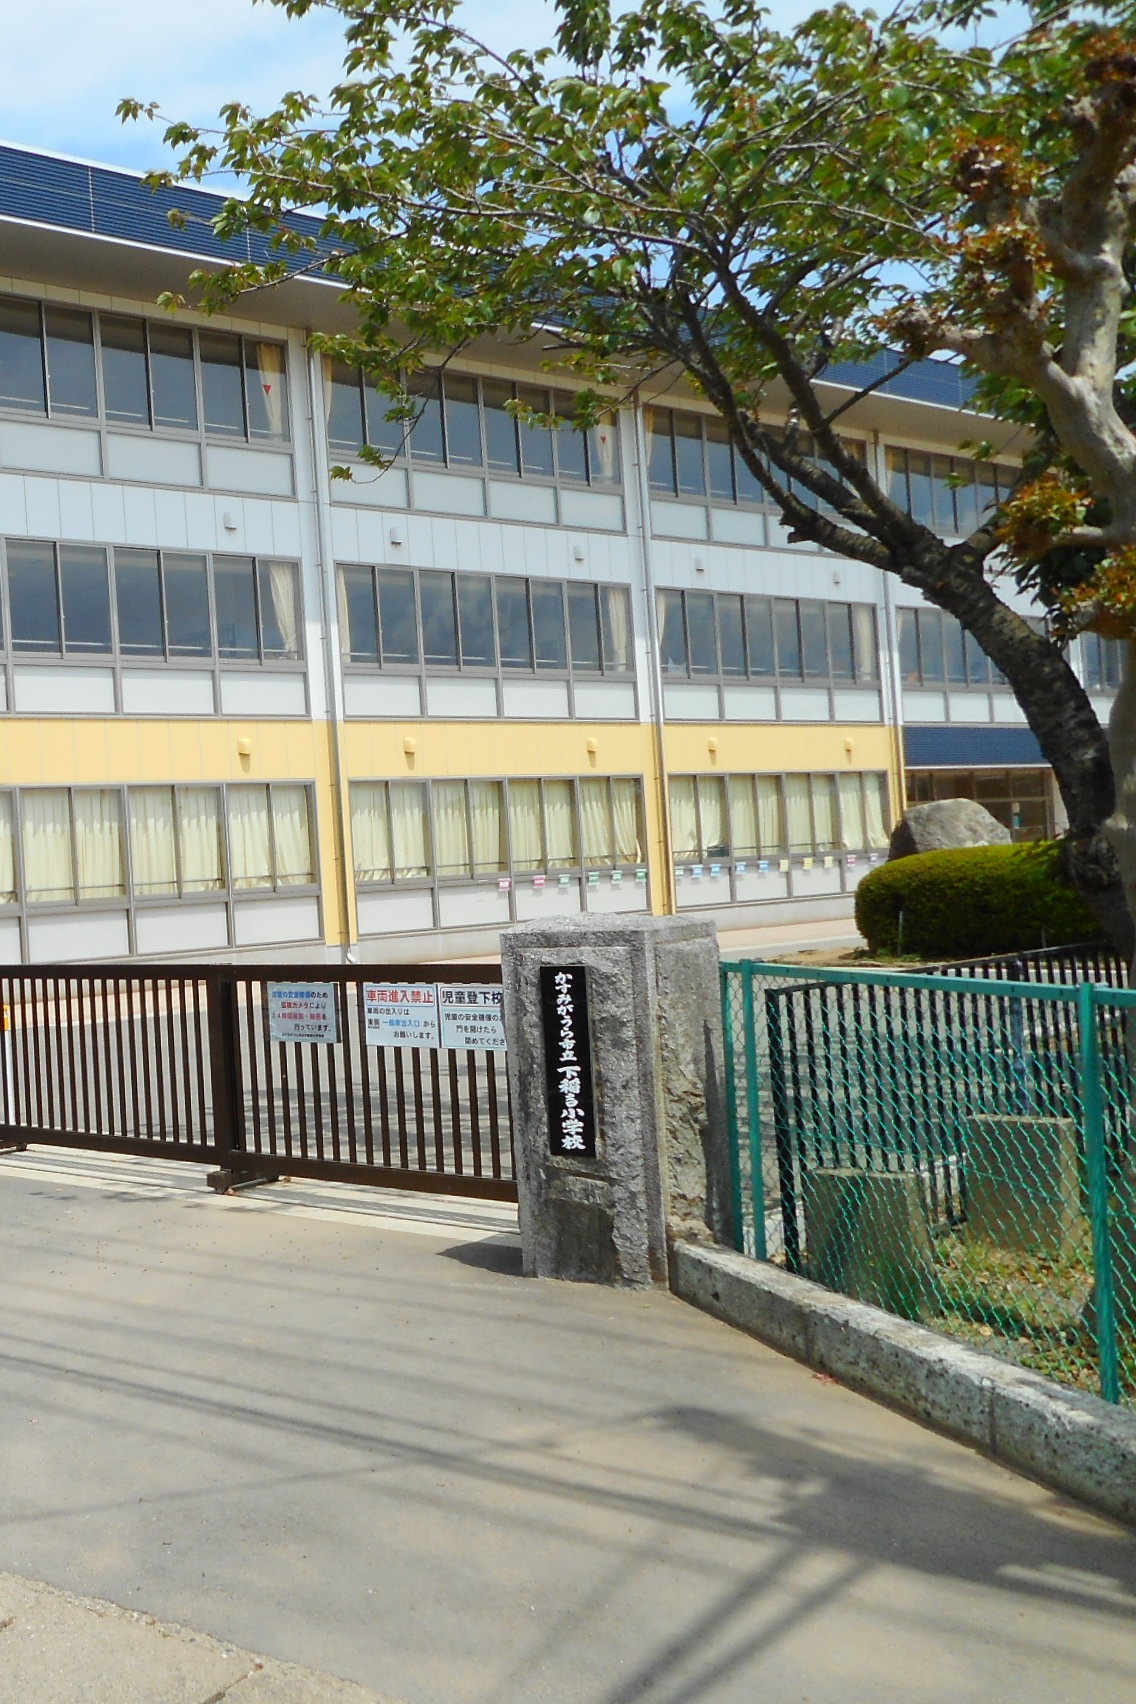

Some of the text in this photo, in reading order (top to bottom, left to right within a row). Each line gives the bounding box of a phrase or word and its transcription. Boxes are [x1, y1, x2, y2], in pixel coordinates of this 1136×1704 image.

[366, 989, 434, 1004] 車両進入禁止
[367, 1007, 410, 1015] 車両の出入りは
